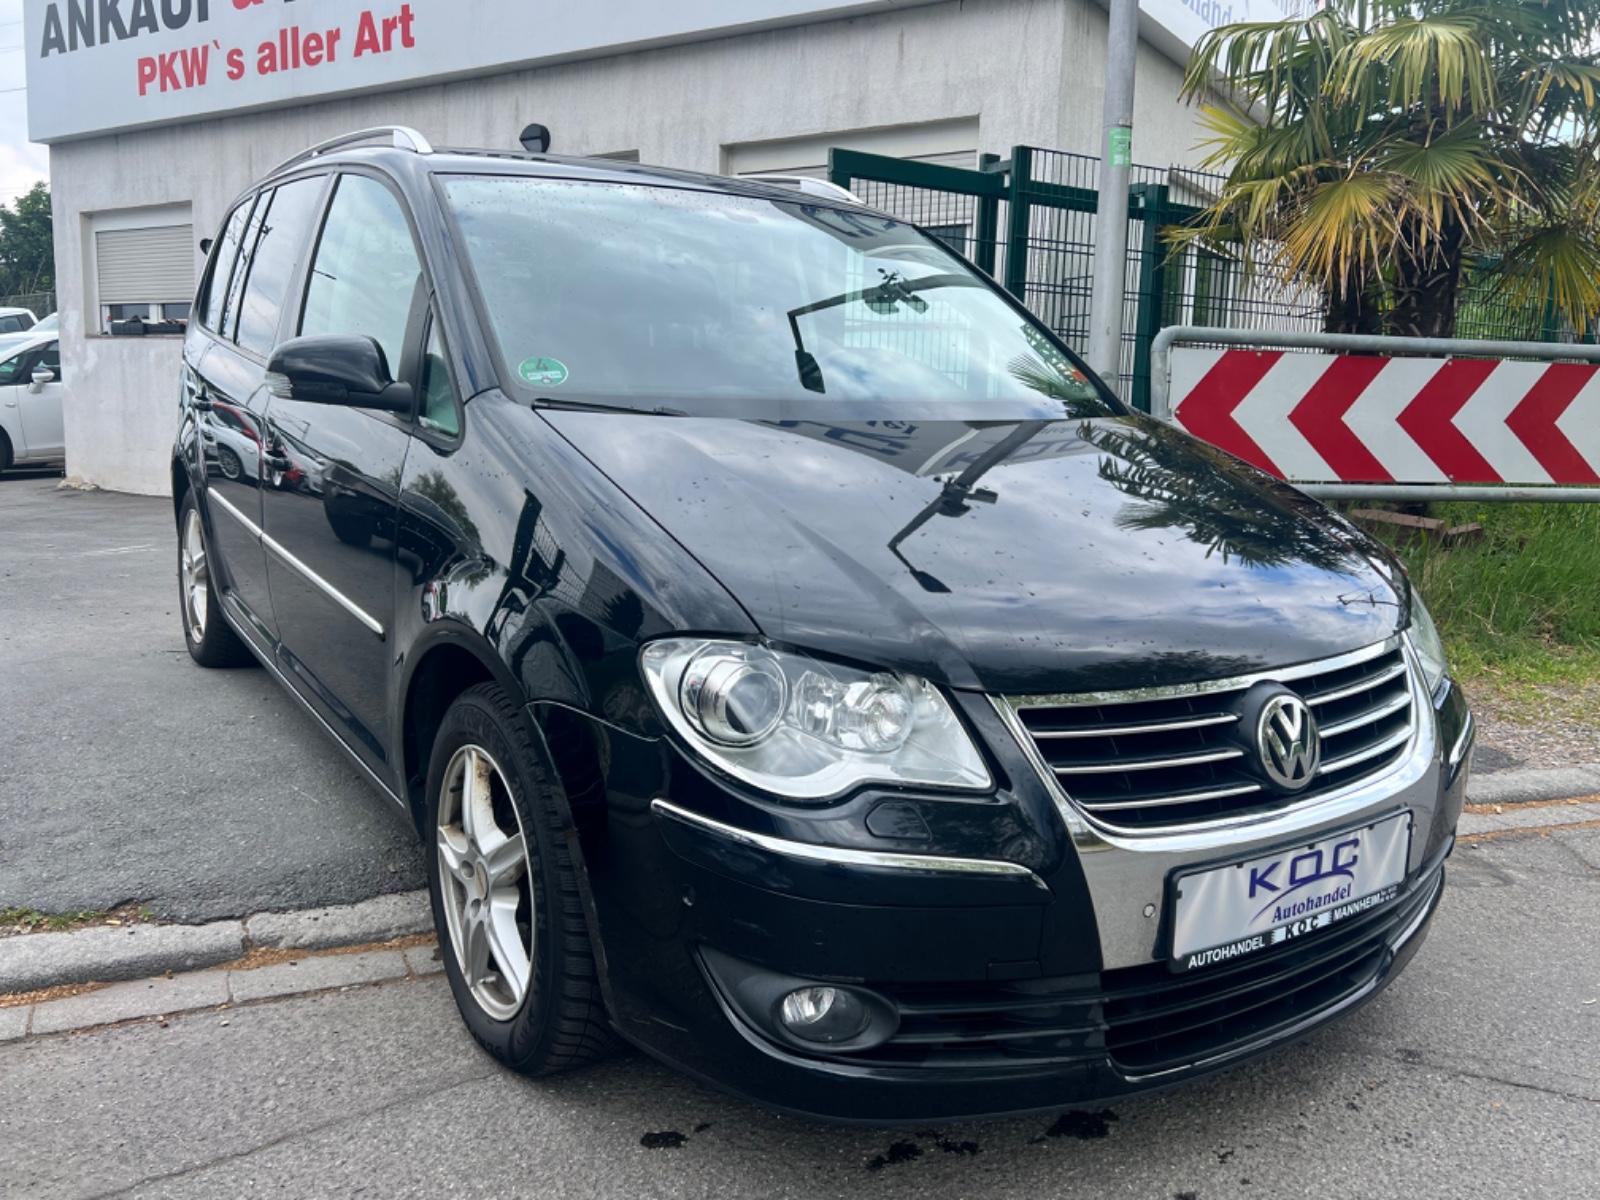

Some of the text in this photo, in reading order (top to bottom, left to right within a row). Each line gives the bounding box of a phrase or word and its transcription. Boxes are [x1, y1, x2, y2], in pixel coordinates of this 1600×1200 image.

[257, 26, 340, 75] aller
[353, 4, 415, 57] Art
[1260, 695, 1319, 788] VW
[1272, 883, 1352, 923] Autohandel
[1188, 936, 1266, 969] AUTOHANDEL
